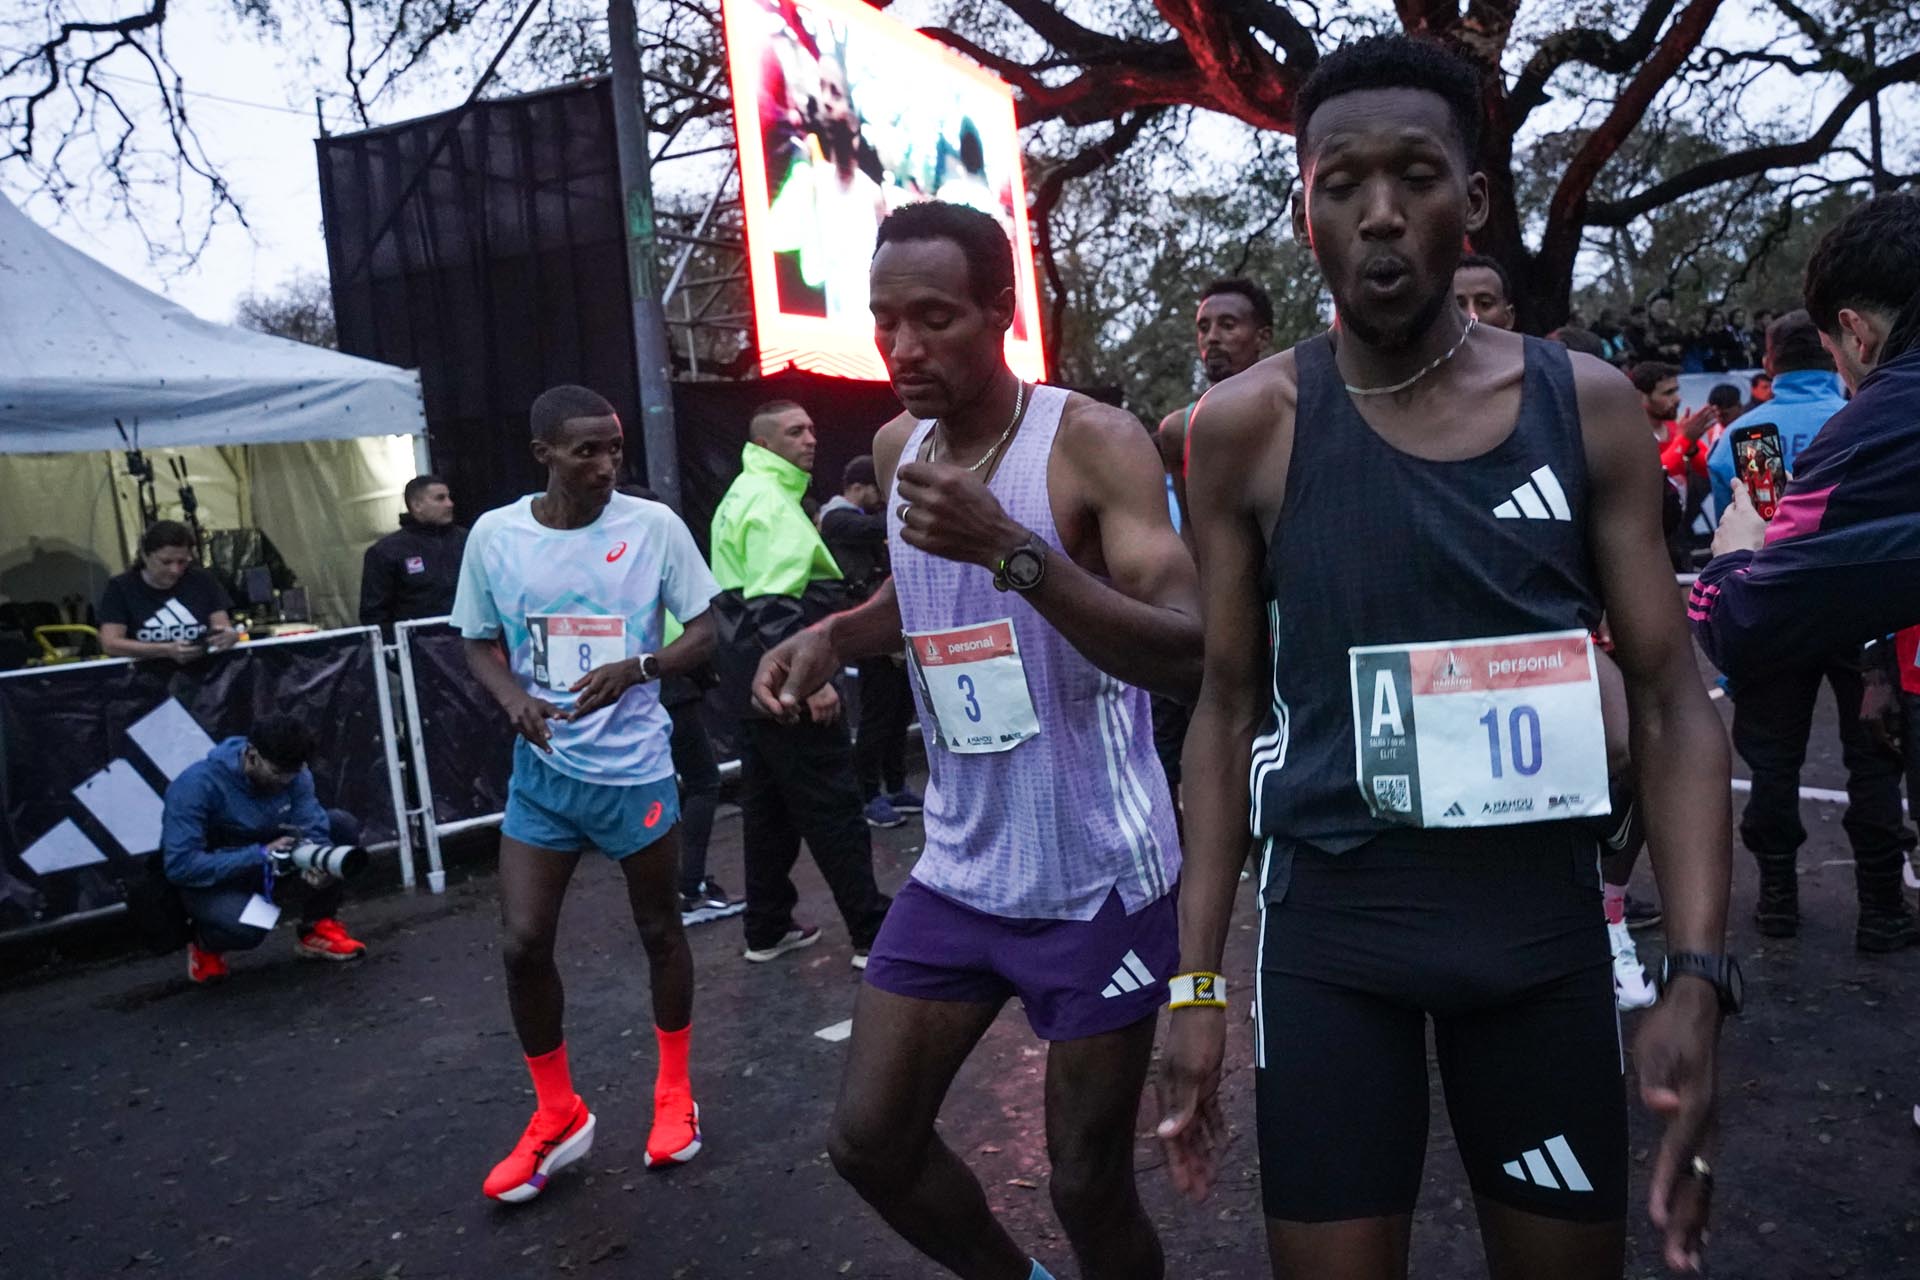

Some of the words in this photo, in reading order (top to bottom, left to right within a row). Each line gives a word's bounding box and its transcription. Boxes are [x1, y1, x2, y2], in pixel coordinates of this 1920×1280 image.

[579, 643, 591, 672] 8
[948, 636, 995, 654] personal
[1489, 651, 1564, 677] personal
[957, 674, 981, 723] 3
[1370, 669, 1406, 737] A
[1380, 748, 1397, 760] ELITE
[1479, 705, 1543, 778] 10
